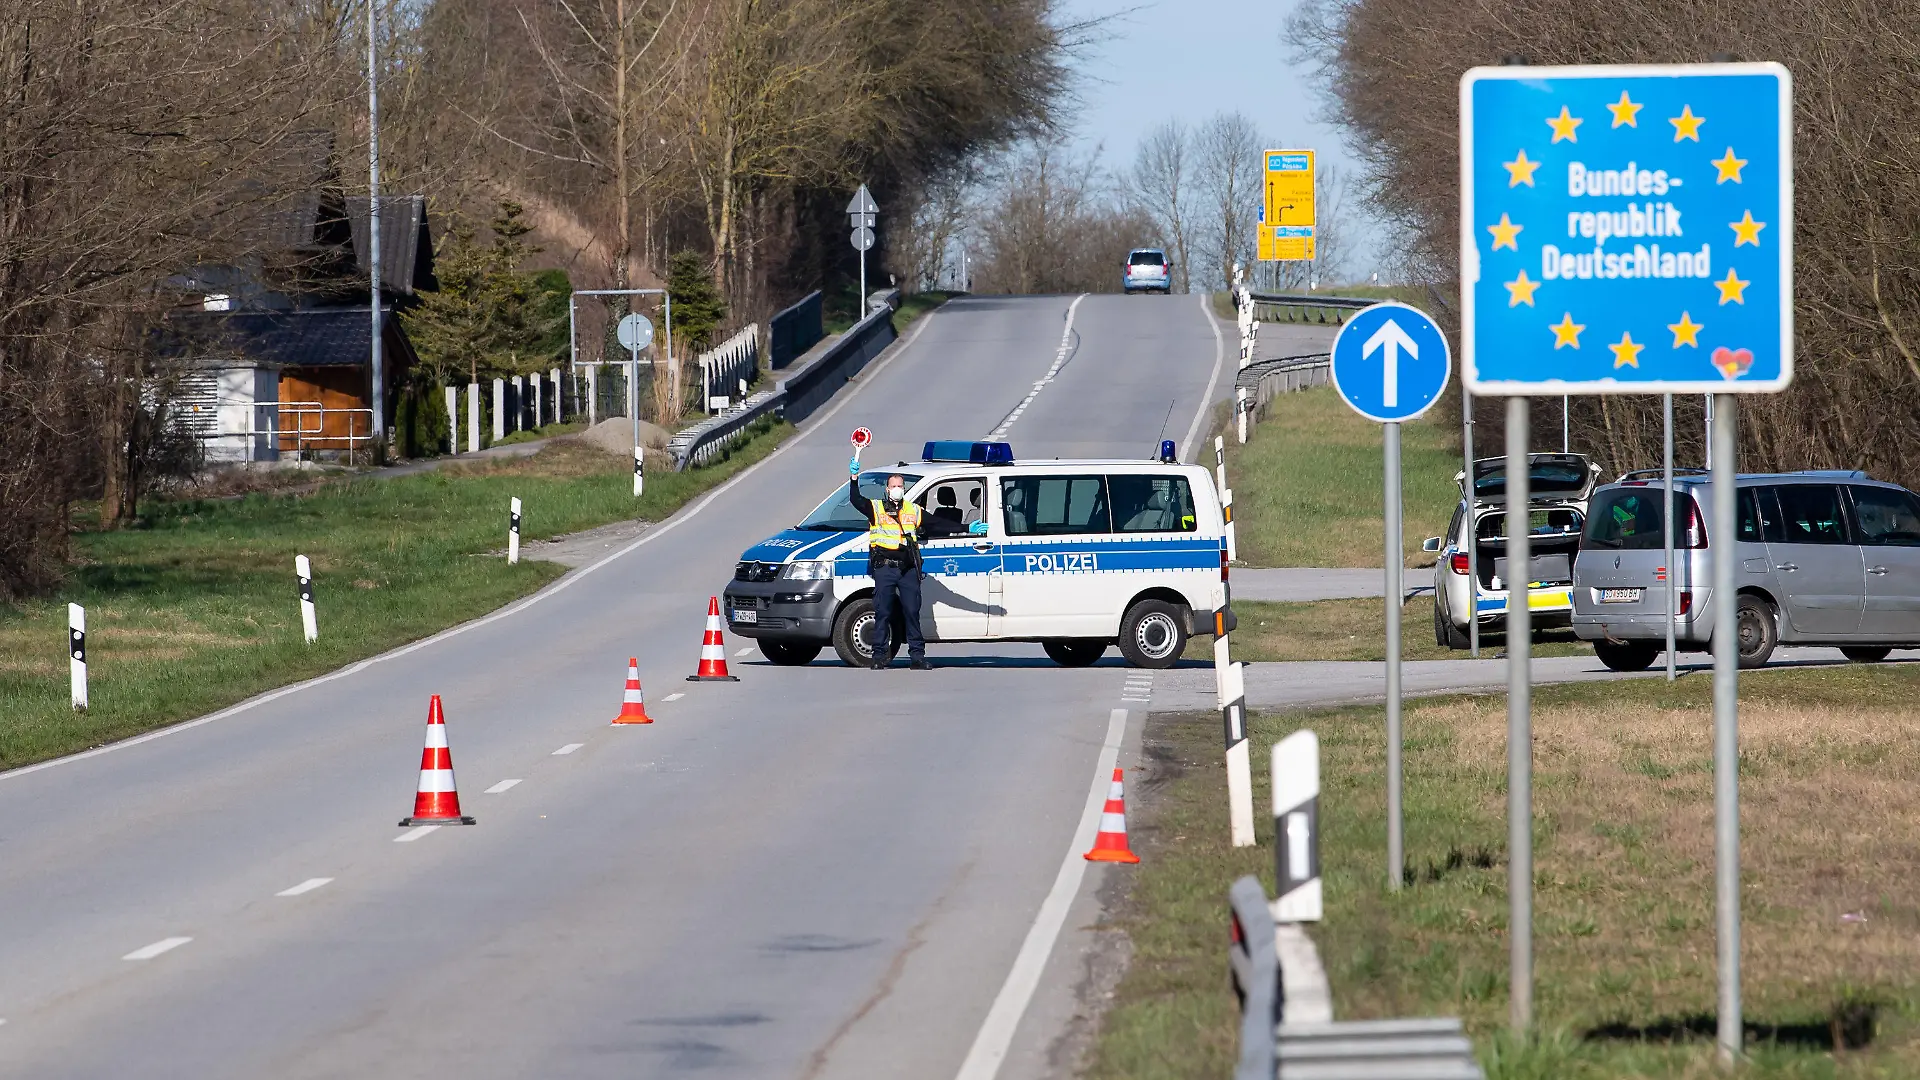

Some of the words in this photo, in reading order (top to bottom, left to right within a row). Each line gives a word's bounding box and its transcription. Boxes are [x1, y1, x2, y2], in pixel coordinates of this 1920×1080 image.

[1568, 161, 1682, 197] Bundes-
[1567, 202, 1682, 246] republik
[1541, 243, 1711, 279] Deutschland
[757, 538, 804, 549] POLIZEI
[1025, 553, 1098, 572] POLIZEI
